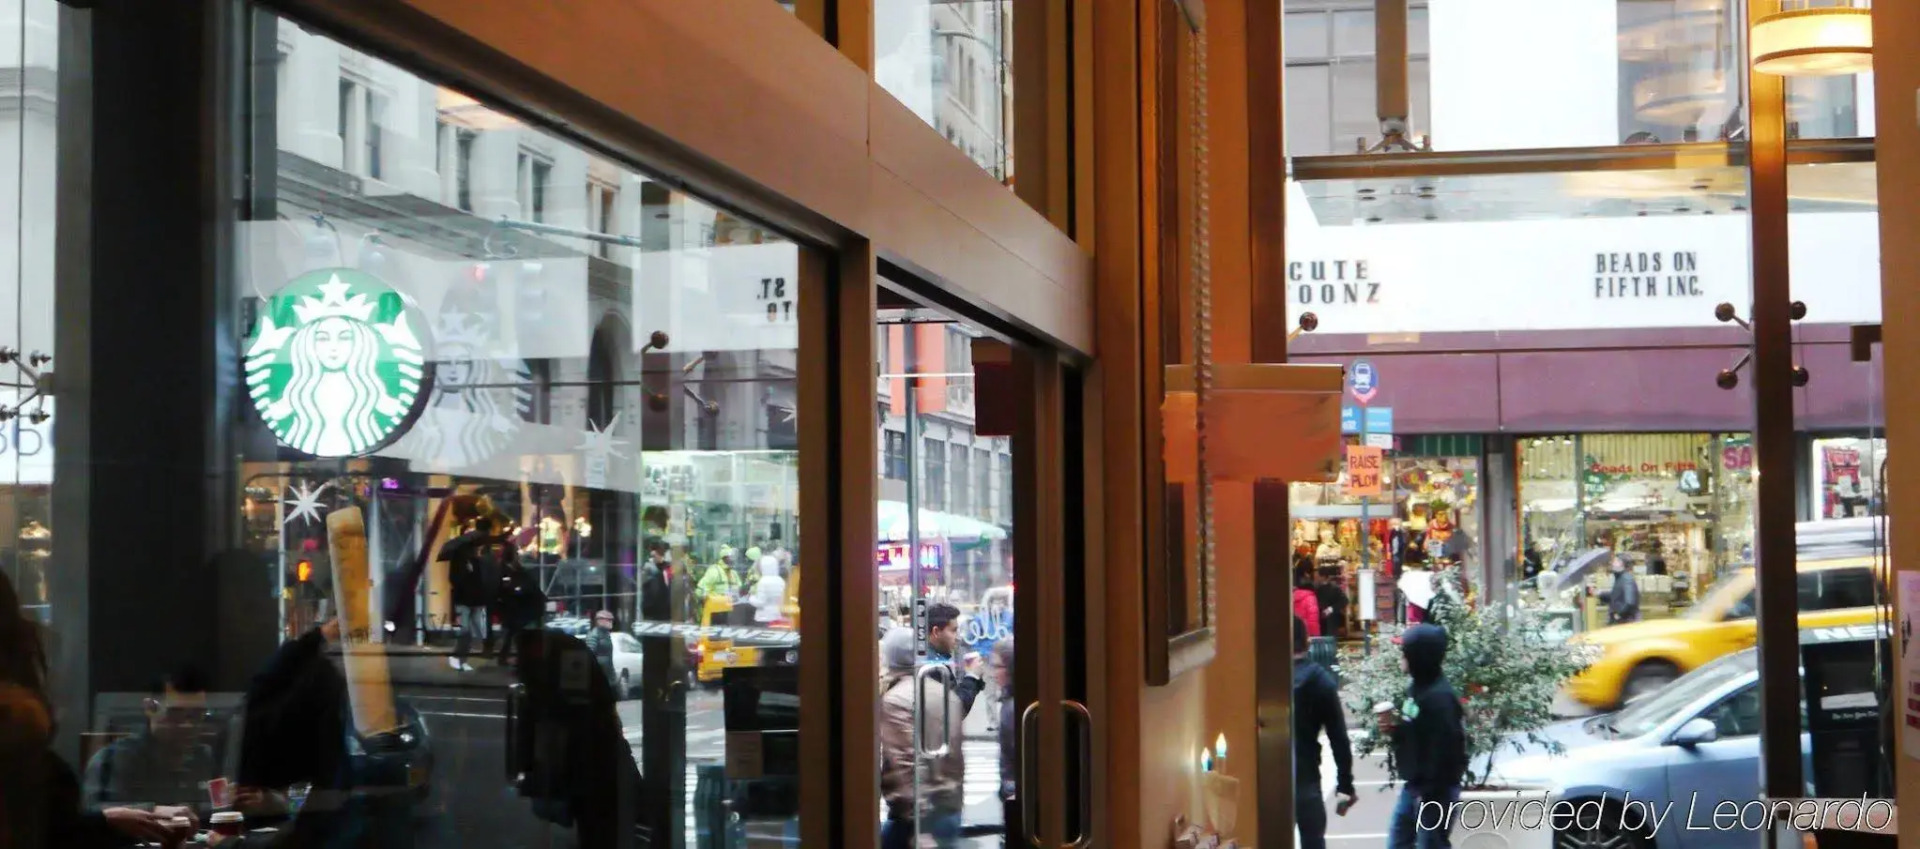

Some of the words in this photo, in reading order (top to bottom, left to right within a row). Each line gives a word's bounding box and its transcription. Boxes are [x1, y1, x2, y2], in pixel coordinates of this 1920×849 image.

[1289, 259, 1369, 281] CUTE
[1595, 252, 1662, 273] BEADS
[1673, 251, 1697, 271] ON
[1288, 283, 1382, 304] OONZ
[1594, 276, 1657, 298] FIFTH
[1667, 275, 1704, 297] INC.
[1349, 456, 1379, 469] RAISE
